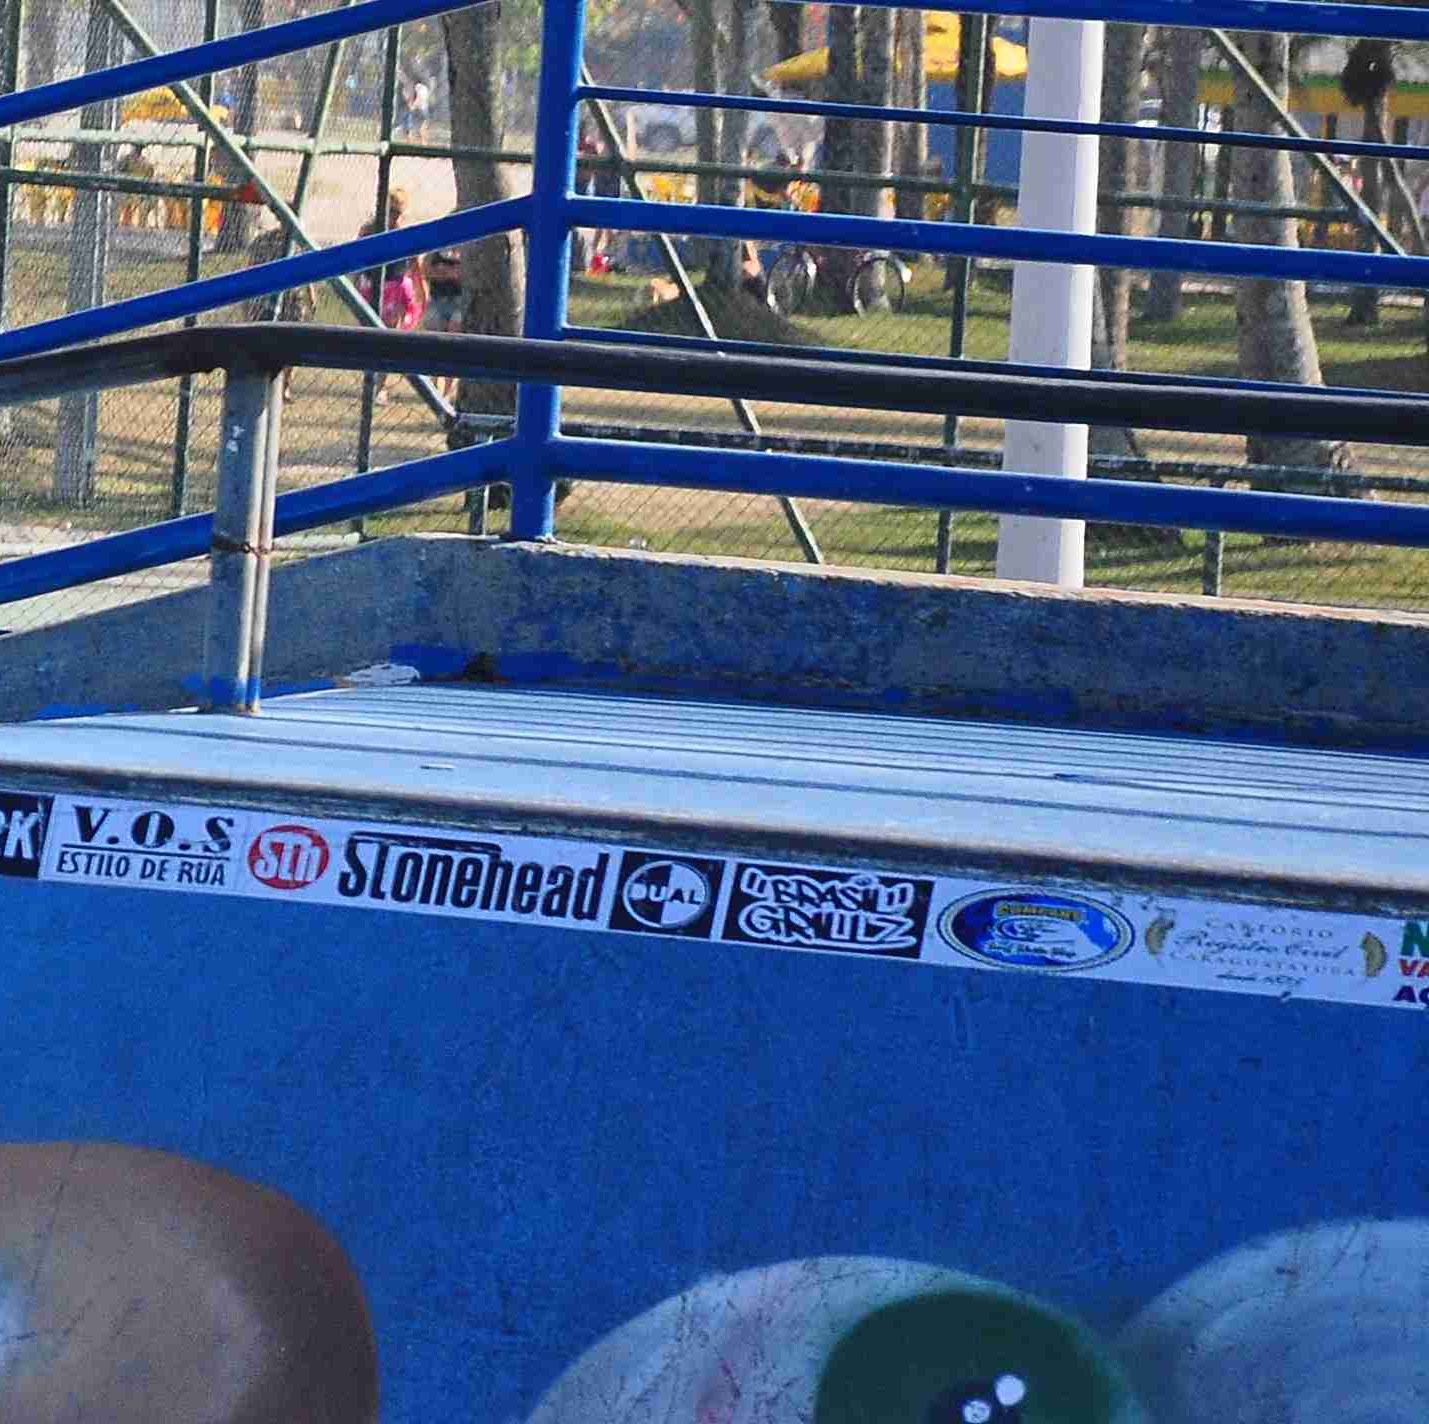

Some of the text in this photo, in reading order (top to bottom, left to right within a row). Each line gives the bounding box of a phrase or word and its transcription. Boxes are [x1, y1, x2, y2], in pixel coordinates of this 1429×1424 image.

[74, 803, 235, 854] V.O.S
[56, 850, 226, 886] ESTILO DE RUA
[338, 830, 610, 921] Stonehead
[631, 881, 701, 907] DUAL
